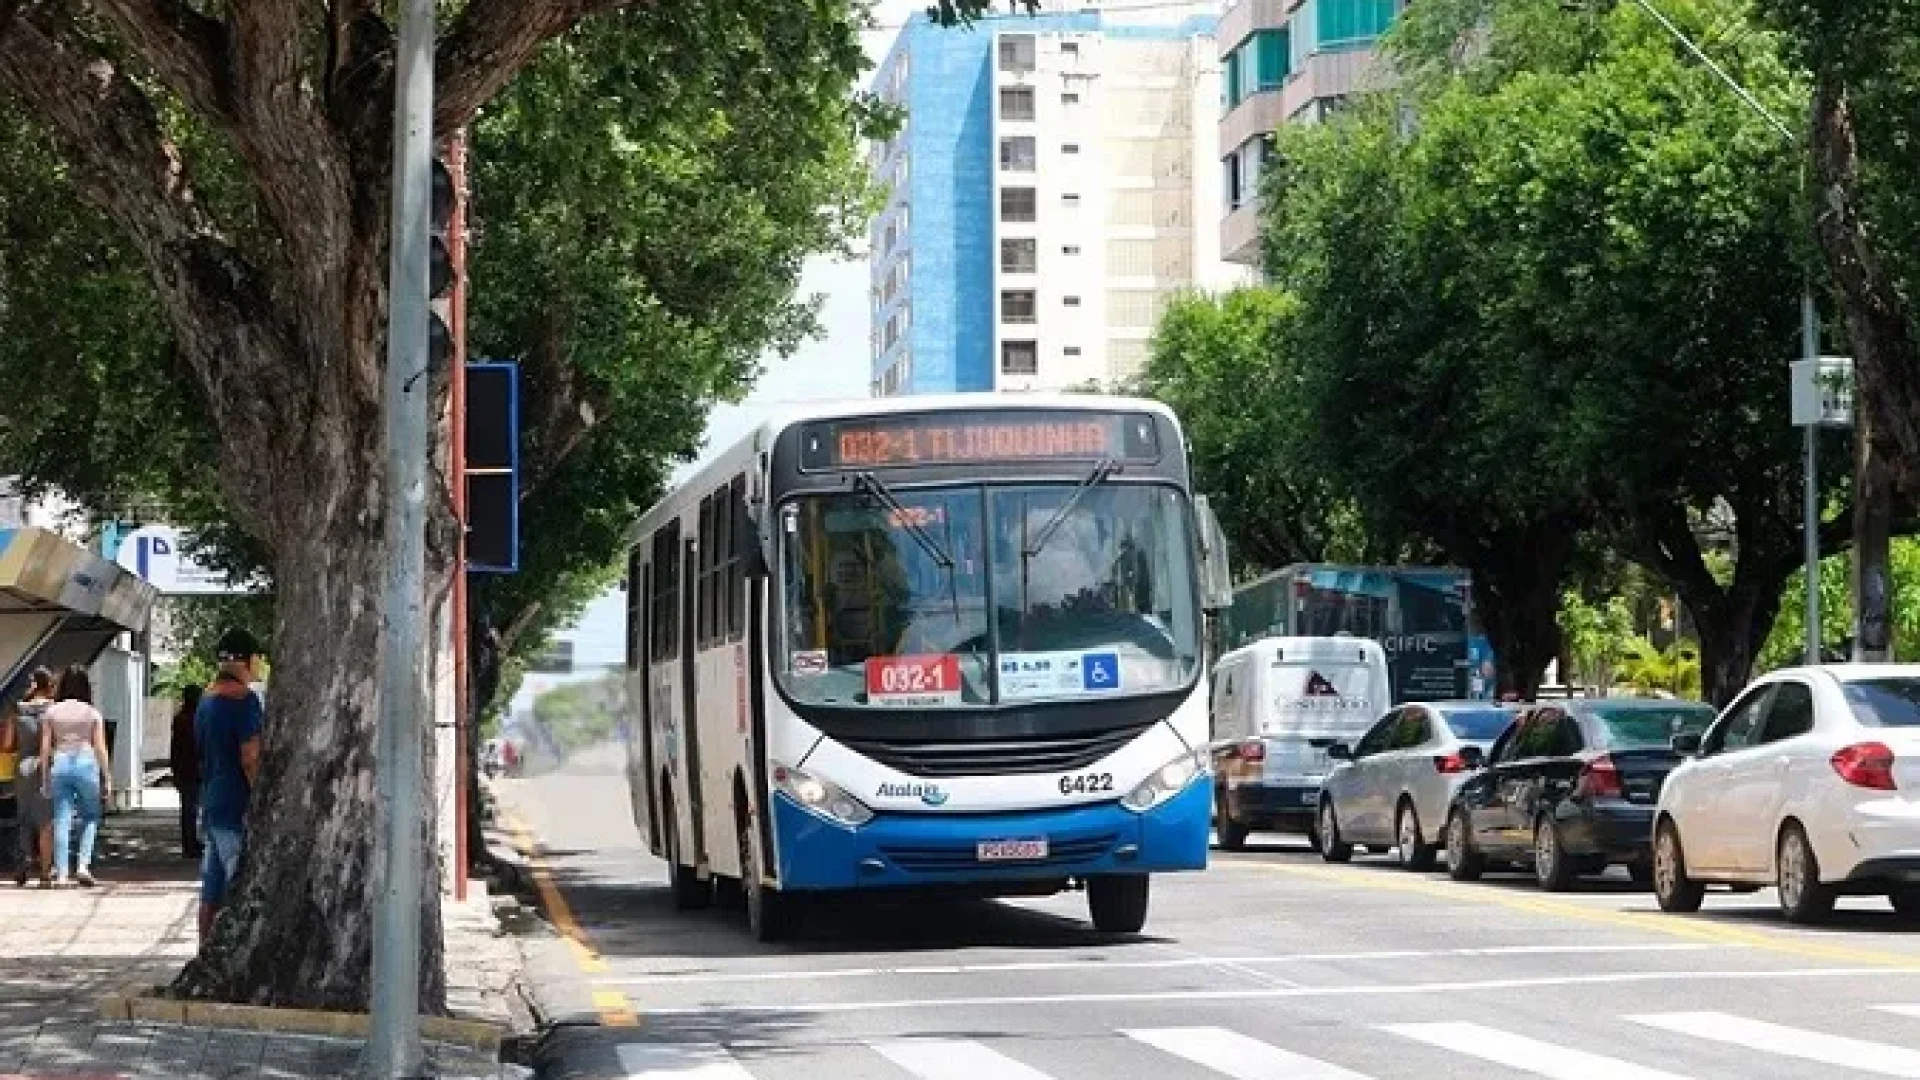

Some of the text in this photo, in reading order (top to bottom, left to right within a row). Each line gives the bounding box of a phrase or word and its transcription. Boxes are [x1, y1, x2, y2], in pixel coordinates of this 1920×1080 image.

[840, 429, 919, 463] 032-1
[1384, 635, 1437, 654] CIFIC
[881, 664, 943, 692] 032-1
[1057, 772, 1113, 796] 6422
